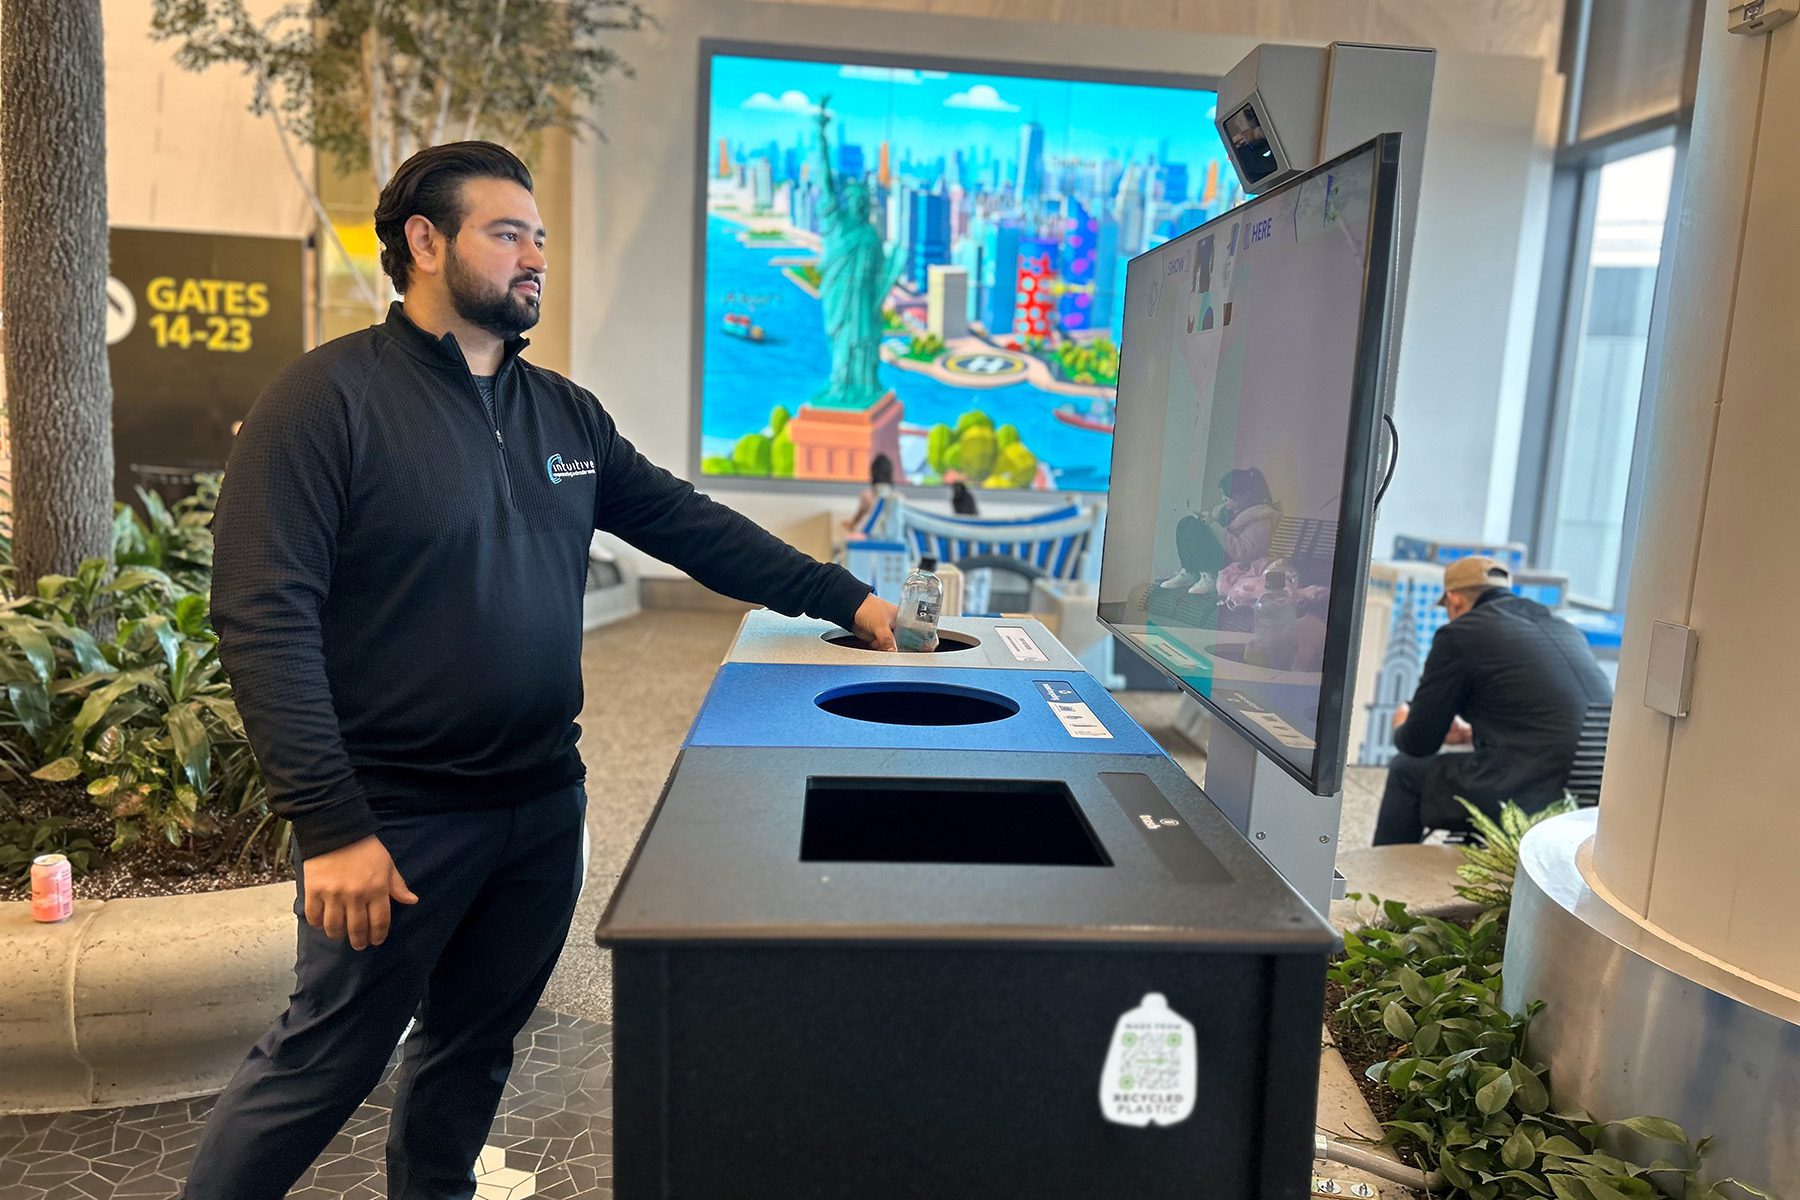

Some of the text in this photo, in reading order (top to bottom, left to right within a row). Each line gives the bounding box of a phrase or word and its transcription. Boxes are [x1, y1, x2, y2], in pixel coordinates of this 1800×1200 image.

[1167, 217, 1273, 276] SHOW HERE
[146, 276, 270, 318] GATES
[150, 314, 252, 353] 14-23
[552, 459, 595, 472] intuitive
[1113, 1093, 1184, 1103] RECYCLED
[1116, 1104, 1179, 1115] PLASTIC
